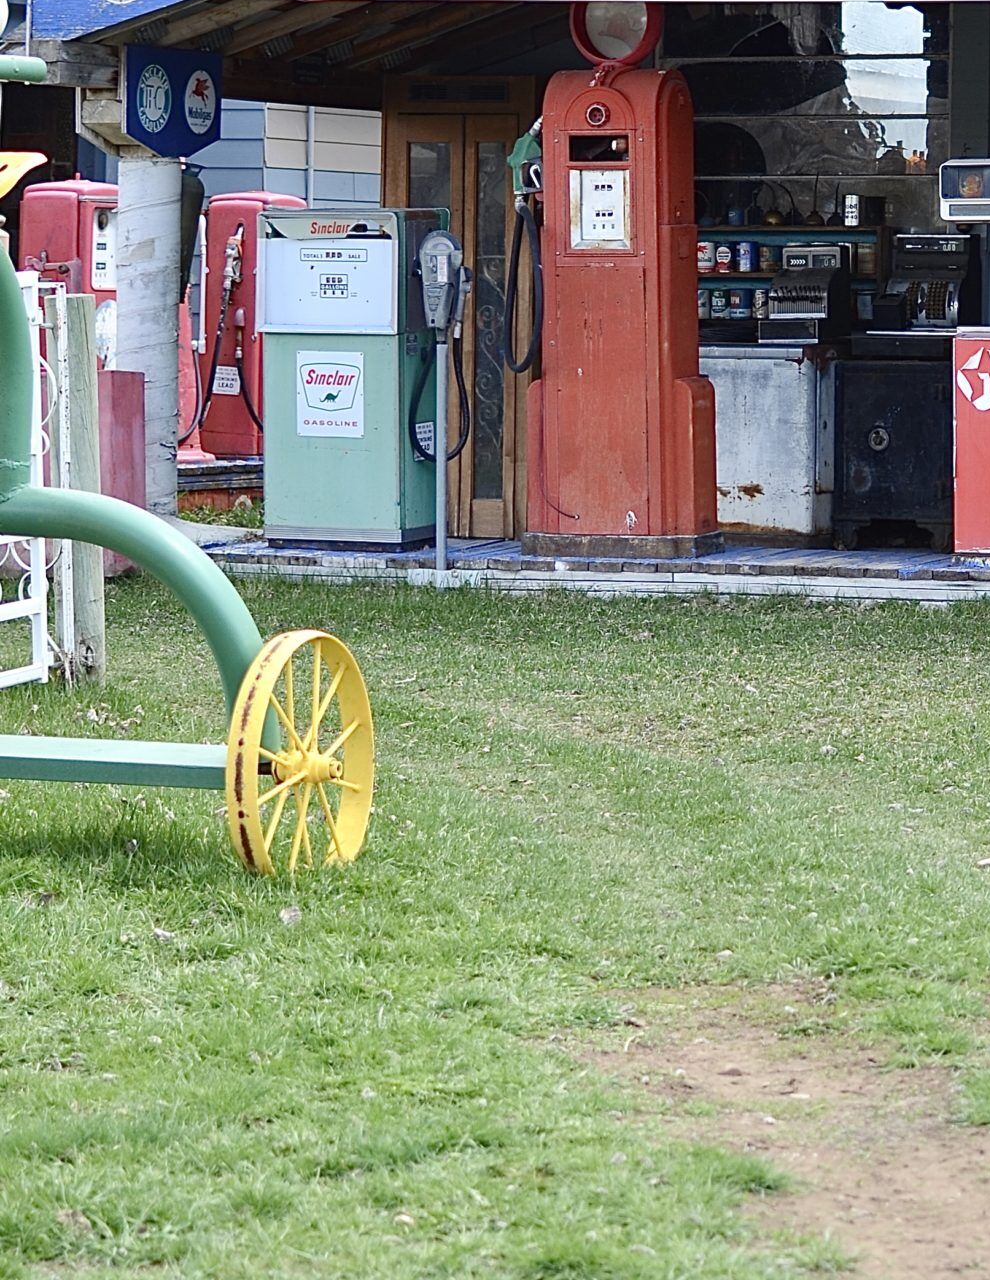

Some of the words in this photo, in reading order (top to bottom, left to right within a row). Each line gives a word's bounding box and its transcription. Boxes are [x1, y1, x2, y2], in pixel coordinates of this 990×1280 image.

[310, 221, 351, 235] Sinclair
[305, 369, 356, 386] Sinclair
[303, 419, 358, 427] GASOLINE
